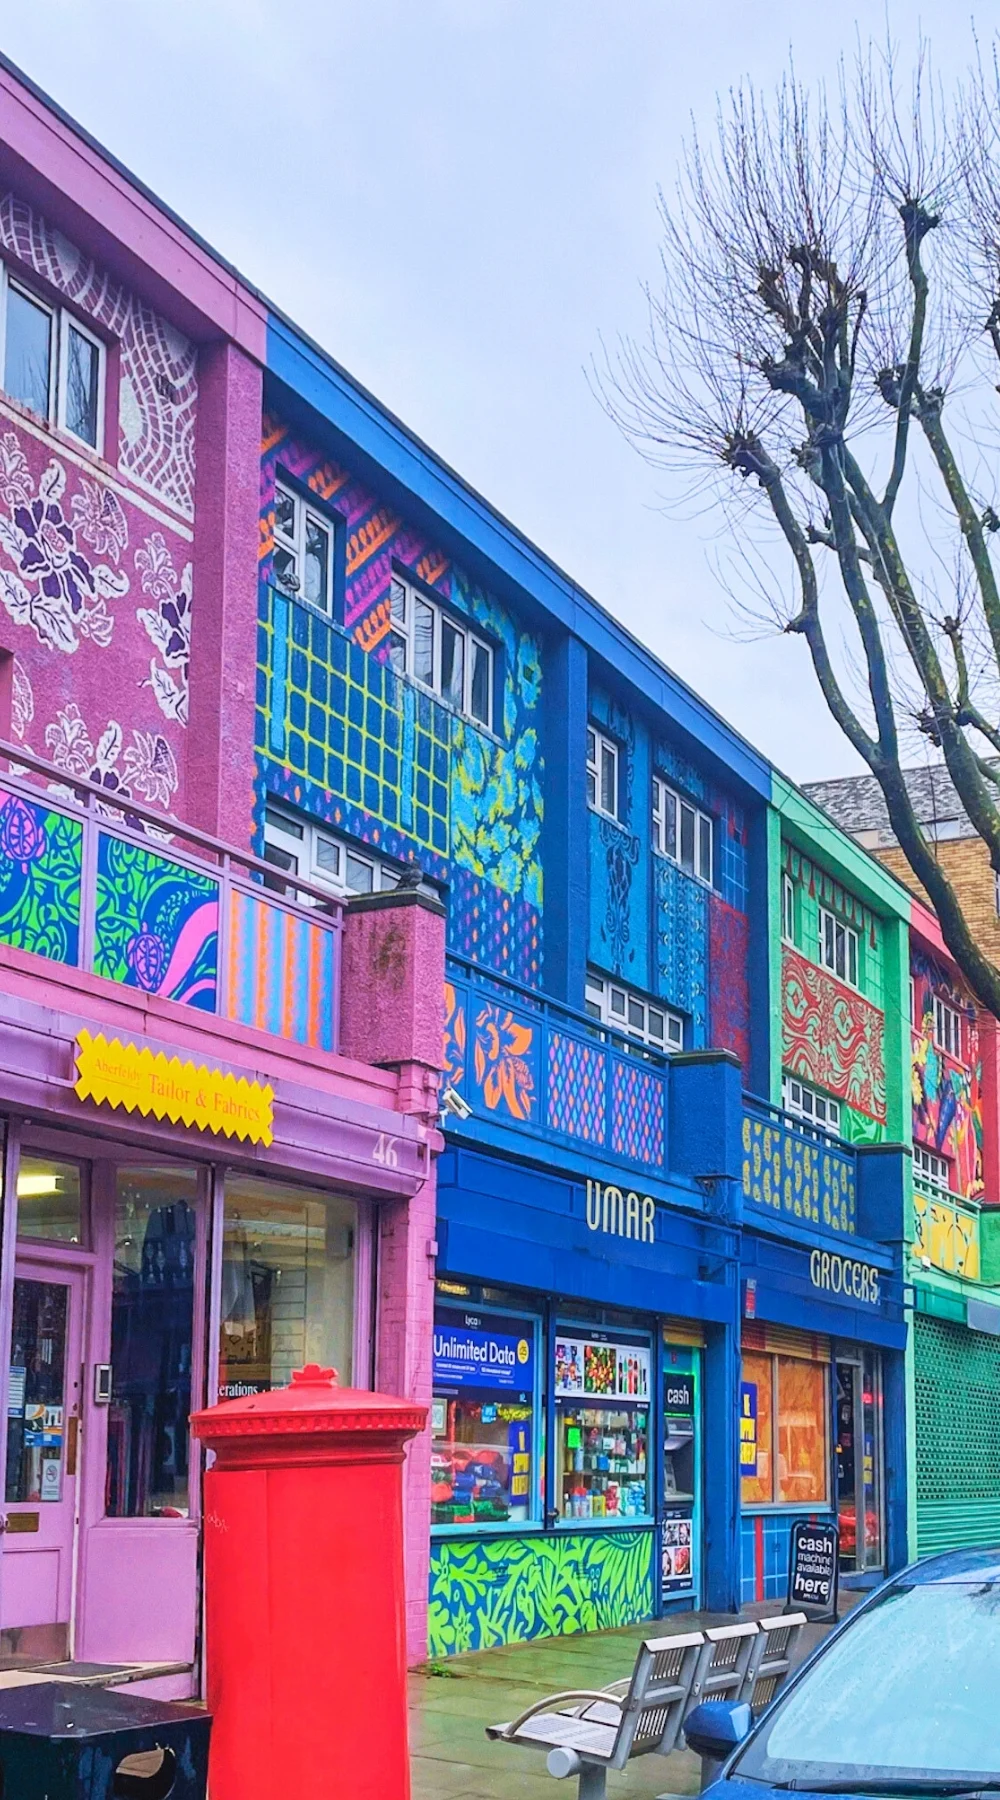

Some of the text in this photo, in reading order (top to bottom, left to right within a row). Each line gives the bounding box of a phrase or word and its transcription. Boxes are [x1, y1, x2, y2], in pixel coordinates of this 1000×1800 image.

[94, 1058, 260, 1122] Aberfeldy Tailor & Fabrics
[372, 1133, 398, 1167] 46
[586, 1179, 655, 1244] UMAR
[810, 1250, 879, 1304] GROCERS
[434, 1334, 488, 1362] Unlimited
[489, 1341, 516, 1365] Data
[667, 1384, 690, 1405] cash
[798, 1537, 833, 1554] cash
[794, 1573, 829, 1595] here
